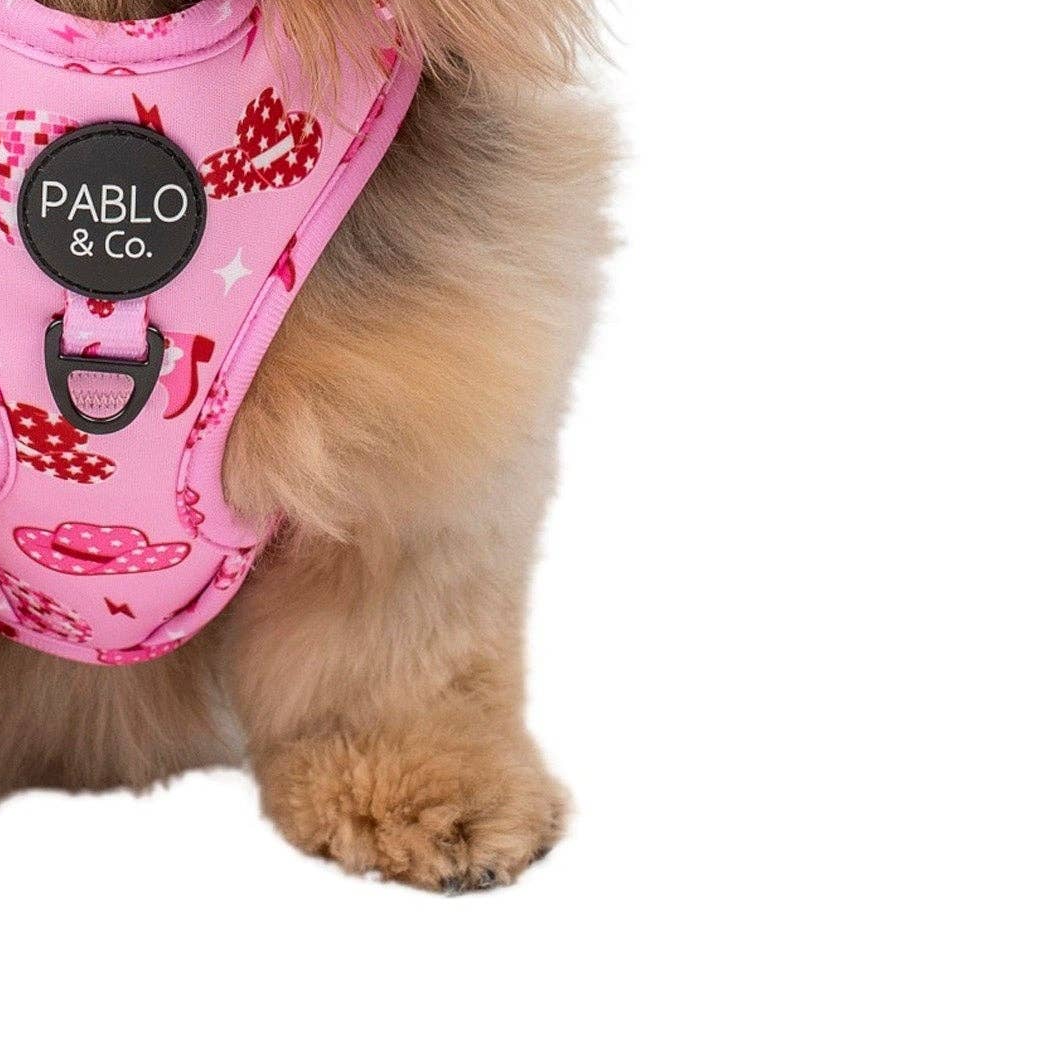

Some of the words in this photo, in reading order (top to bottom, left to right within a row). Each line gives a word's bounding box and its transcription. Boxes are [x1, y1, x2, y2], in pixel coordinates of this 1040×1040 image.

[41, 180, 188, 223] PABLO
[69, 228, 94, 257] &
[104, 230, 153, 259] Co.
